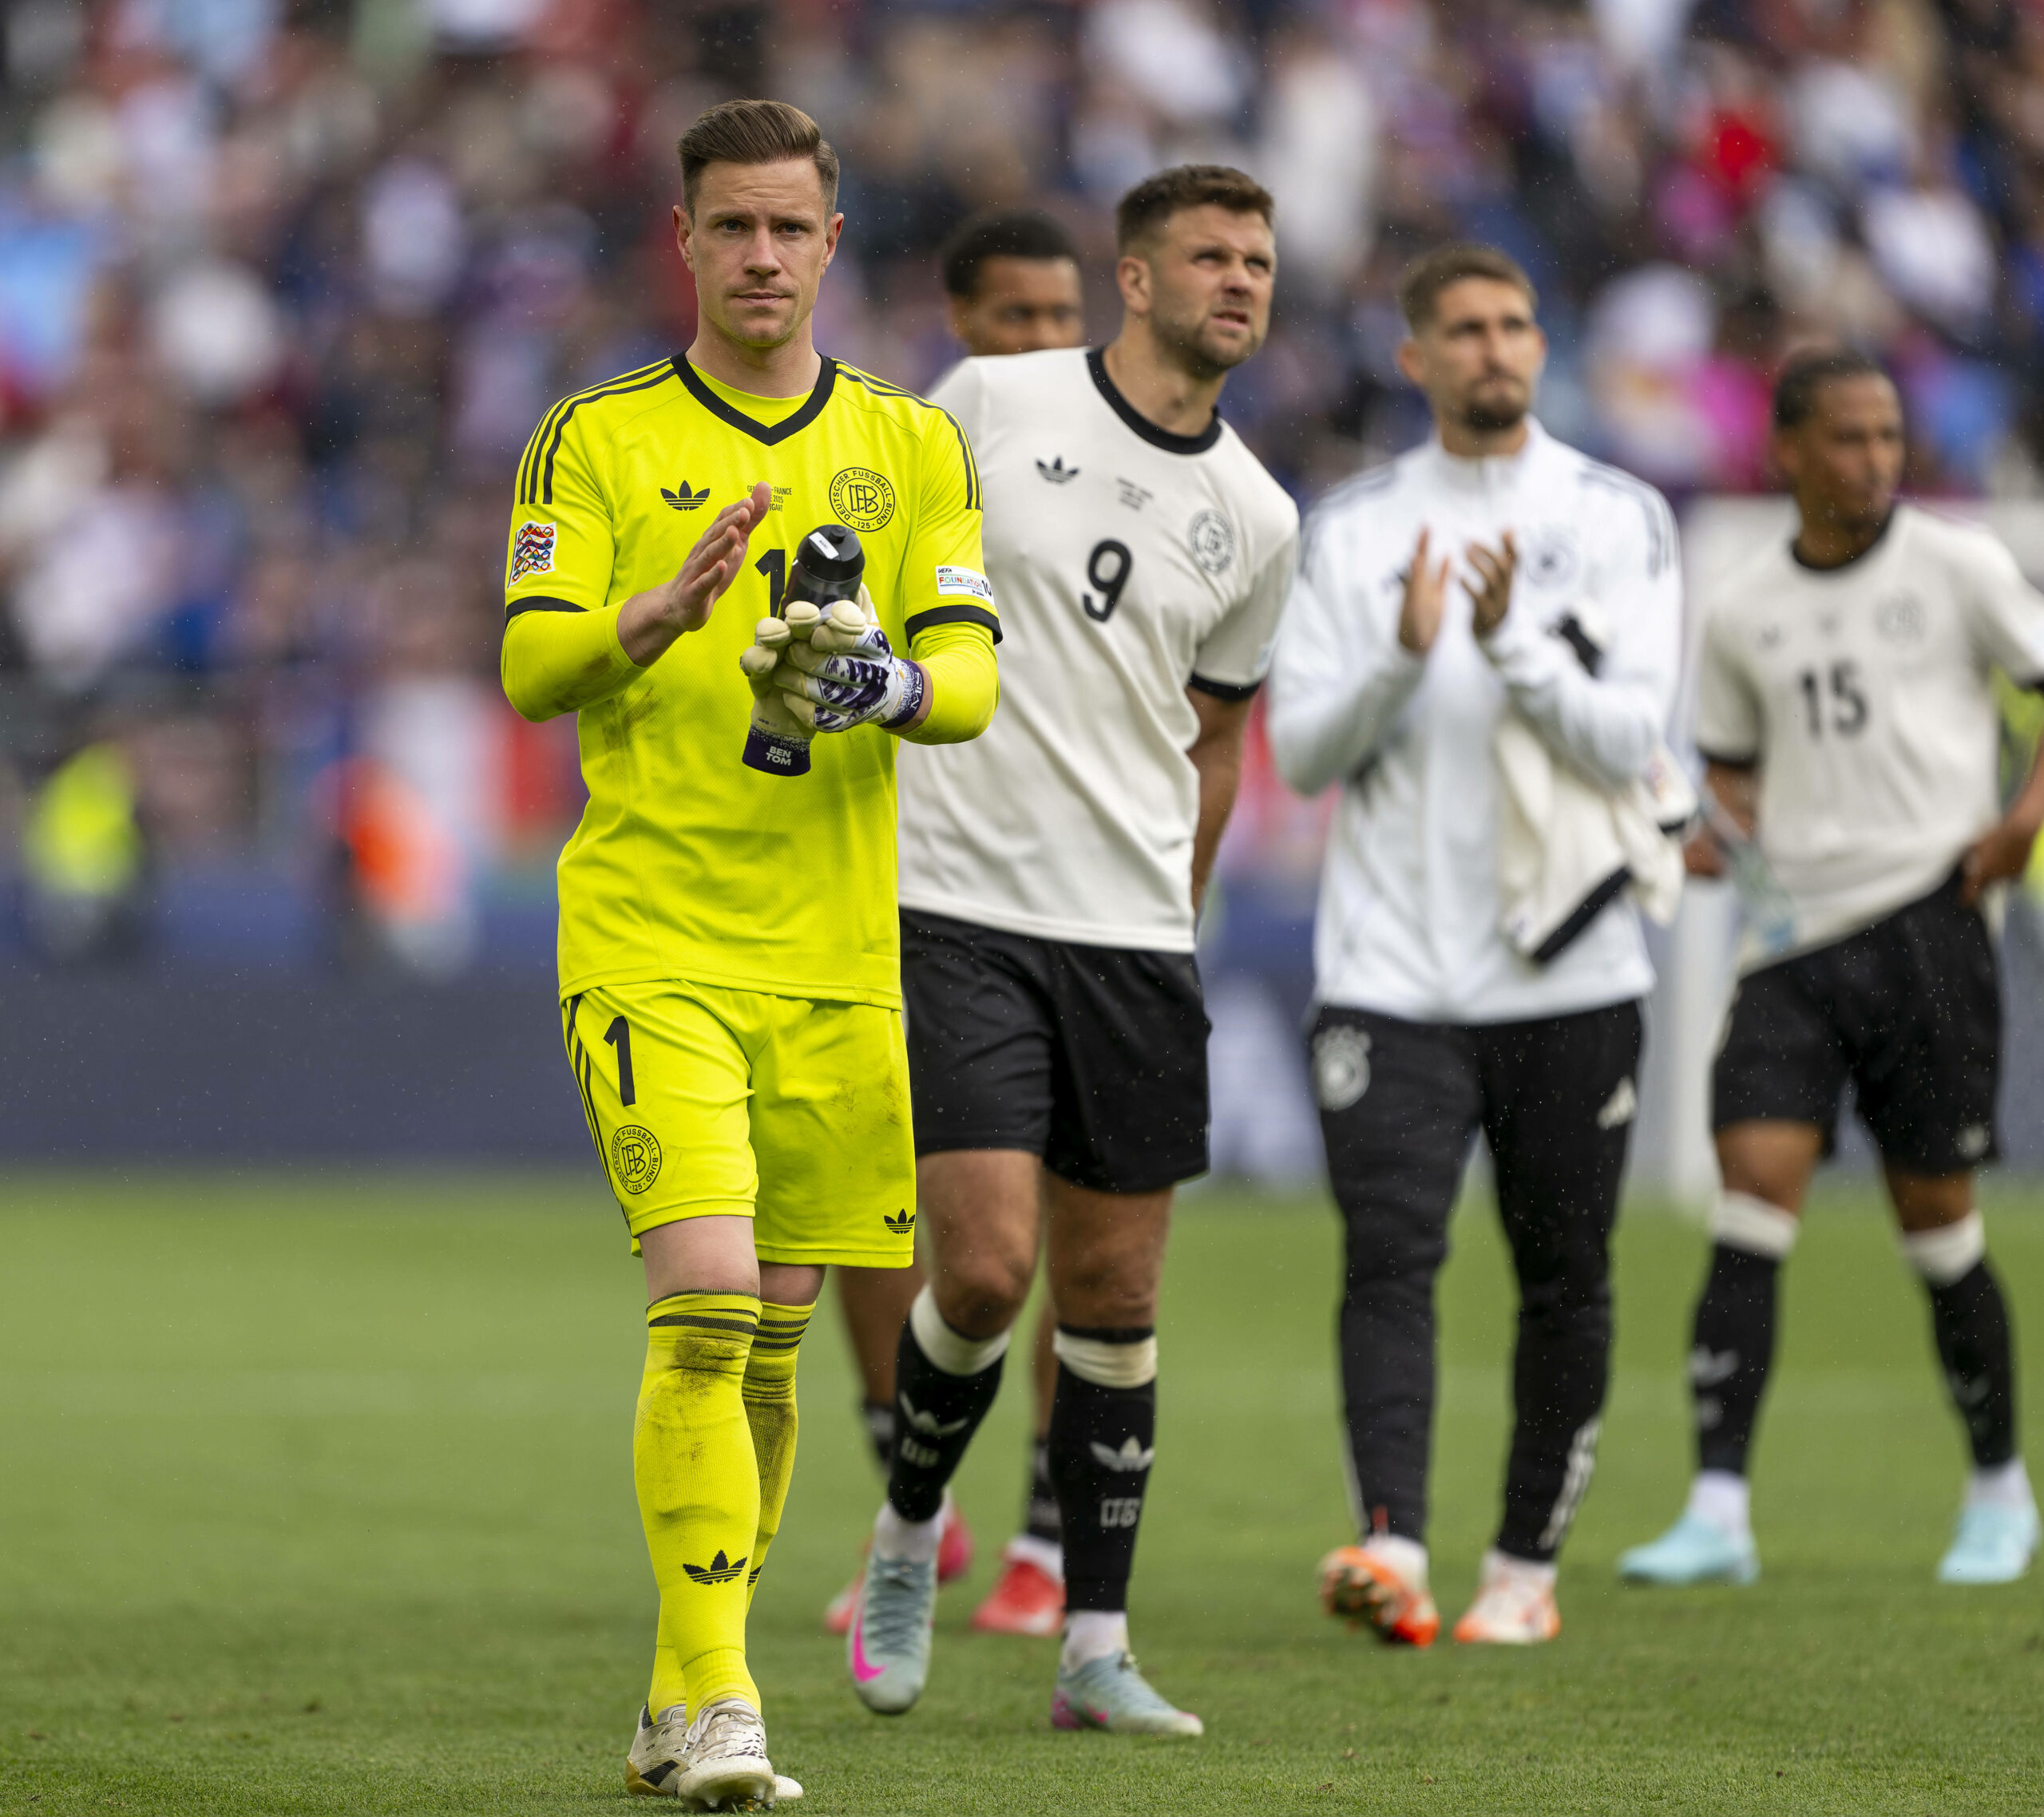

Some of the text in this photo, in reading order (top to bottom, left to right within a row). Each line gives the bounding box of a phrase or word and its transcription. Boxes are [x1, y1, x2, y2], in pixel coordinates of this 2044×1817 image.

[774, 486, 792, 496] FRANCE
[833, 470, 893, 525] DEUTSCHER FUSSBALL-BUND
[858, 521, 871, 529] 125
[755, 548, 786, 618] 1
[939, 576, 983, 589] FOUNDATION
[1082, 537, 1133, 623] 9
[1800, 658, 1868, 742] 15
[766, 752, 792, 766] TOM
[769, 746, 792, 758] BEN
[603, 1015, 636, 1107] 1
[613, 1135, 628, 1187] DEUTSCHER
